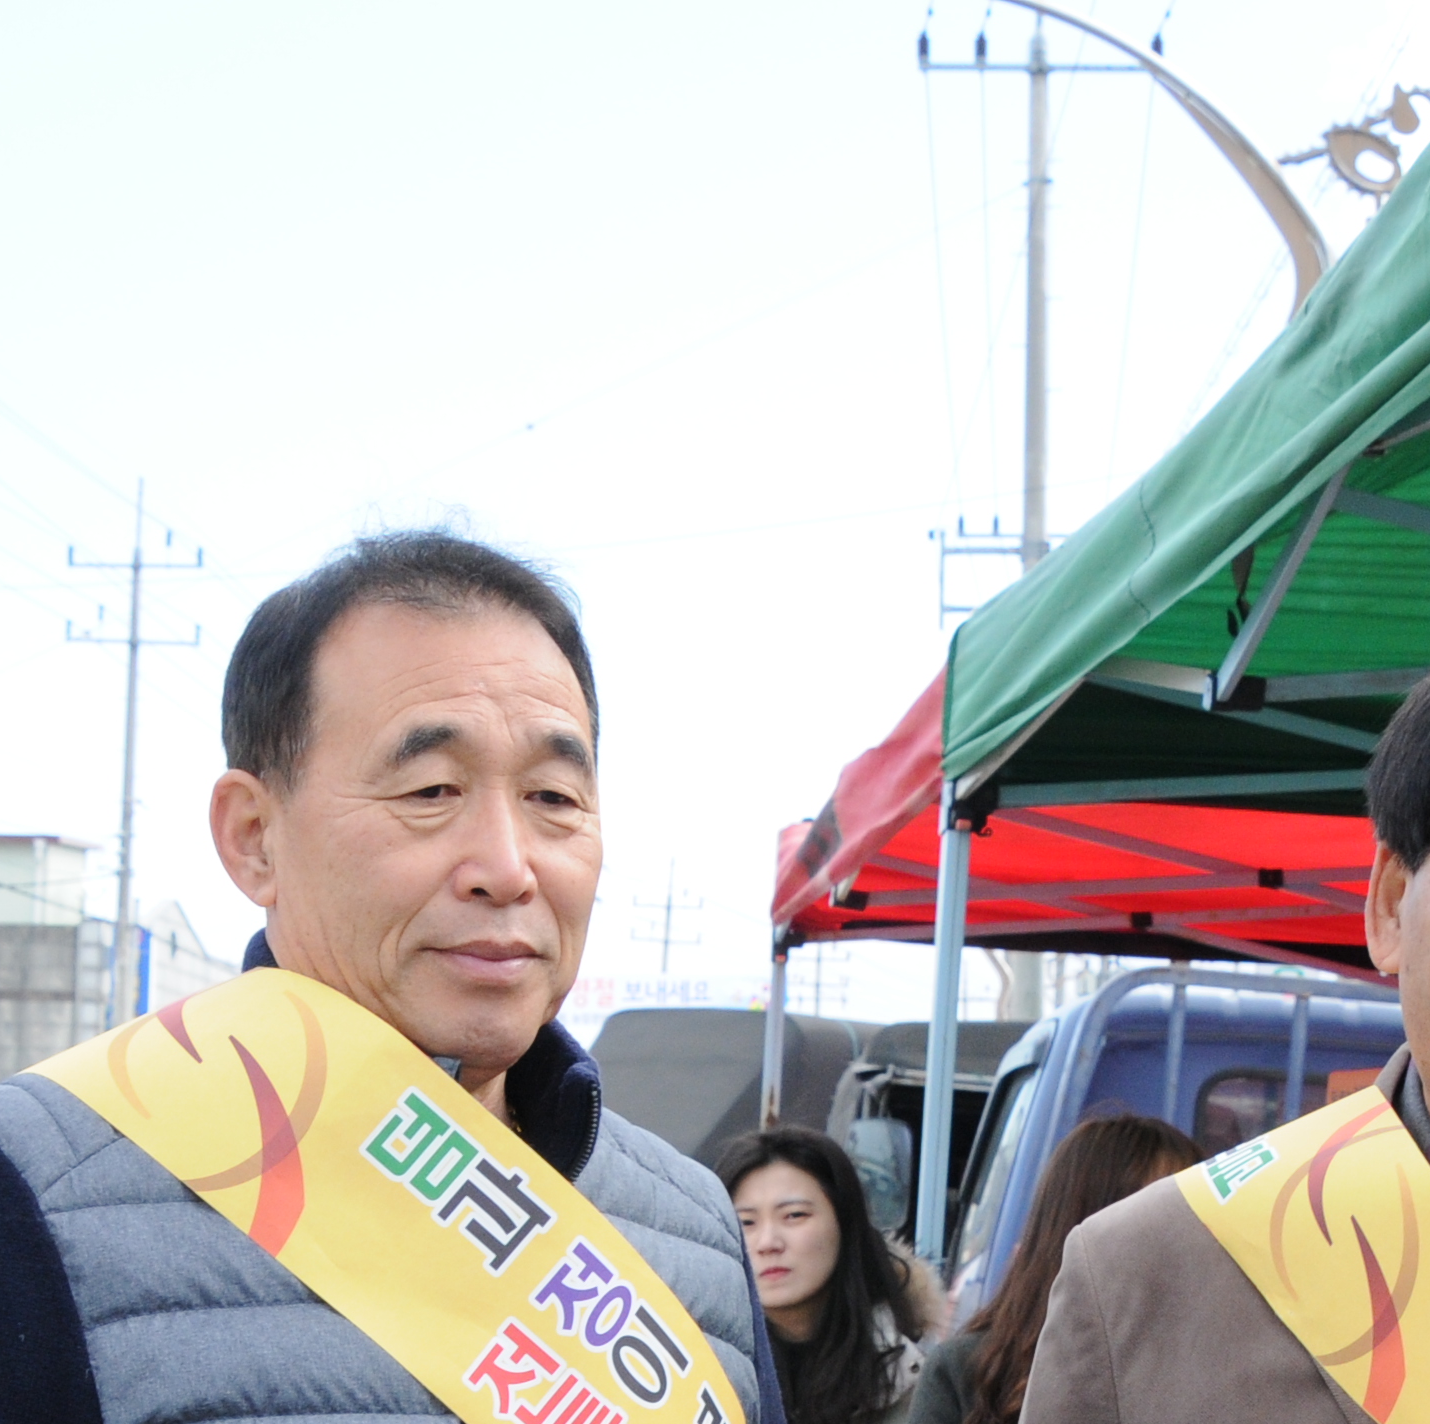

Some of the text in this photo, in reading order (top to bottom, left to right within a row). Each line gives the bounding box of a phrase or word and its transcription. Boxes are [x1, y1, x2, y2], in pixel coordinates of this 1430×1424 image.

[622, 980, 714, 1004] 보내세요
[1200, 1137, 1275, 1200] 덤
[366, 1092, 551, 1271] 덤과
[535, 1242, 691, 1405] 정이
